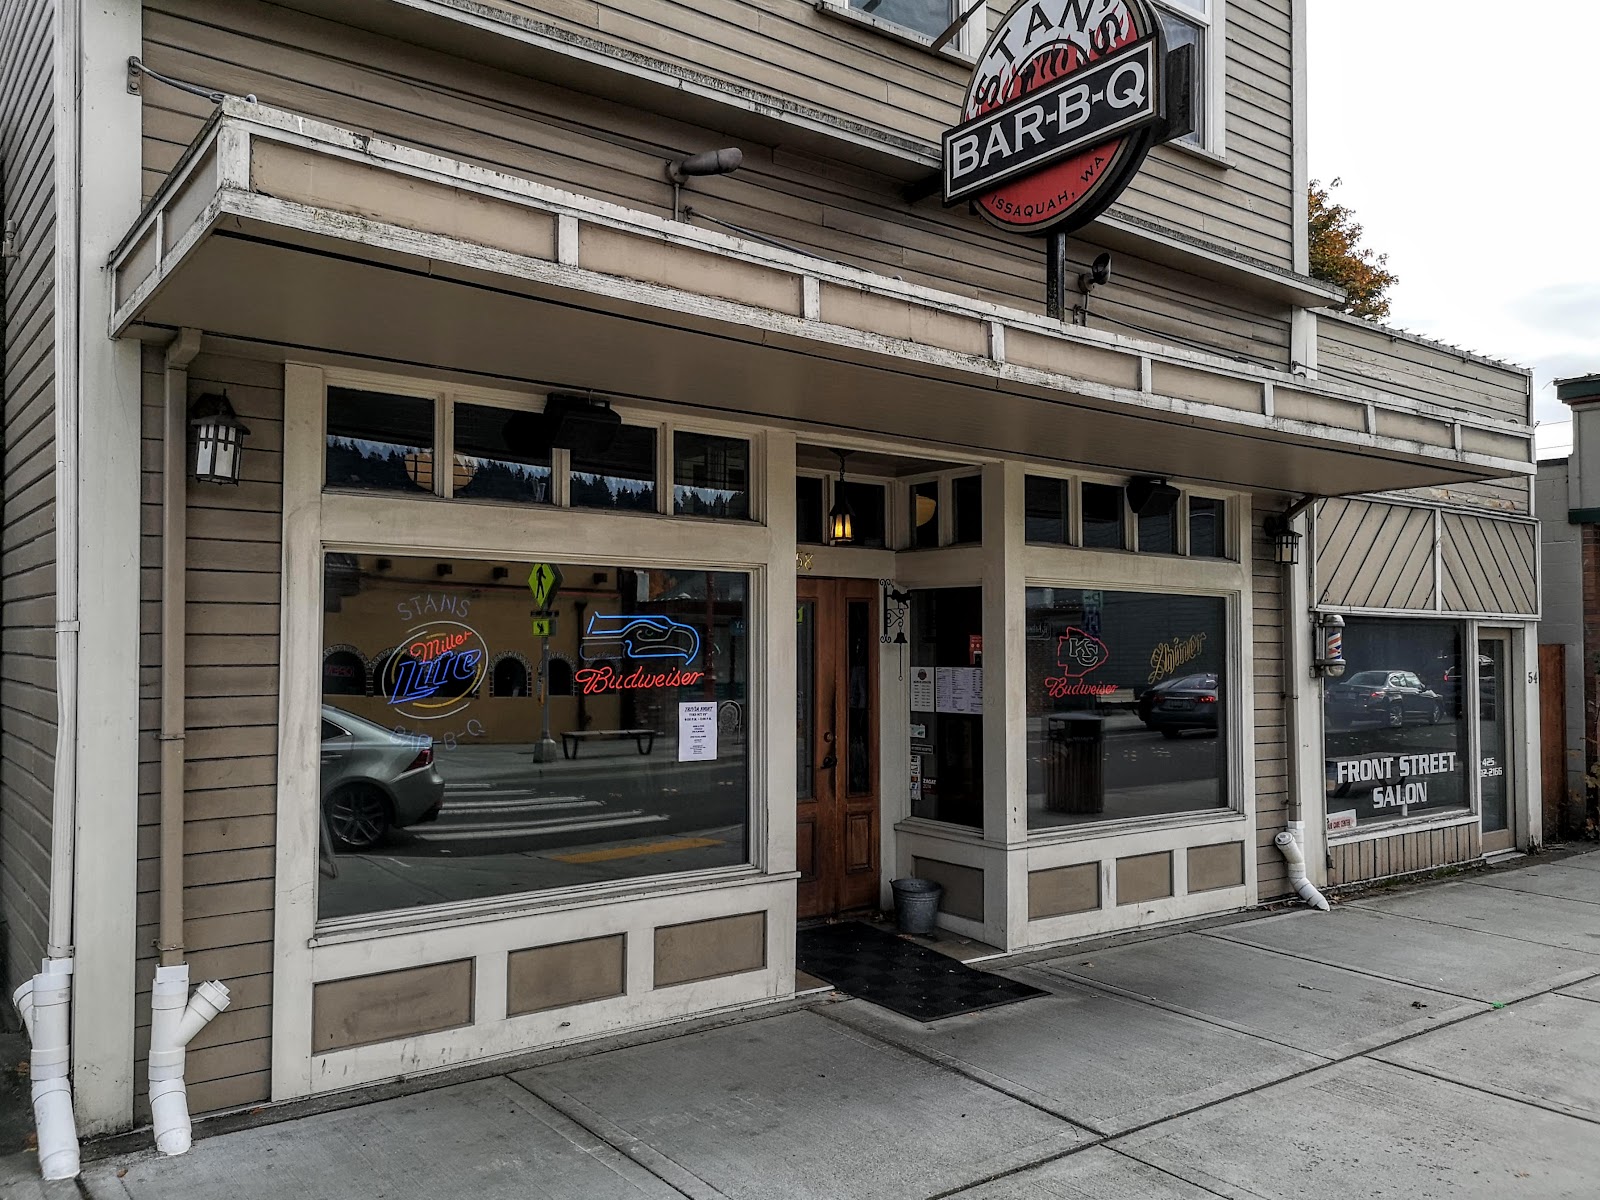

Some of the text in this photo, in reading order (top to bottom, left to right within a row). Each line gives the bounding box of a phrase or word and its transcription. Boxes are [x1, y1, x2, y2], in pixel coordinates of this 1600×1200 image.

[951, 60, 1147, 180] BAR-B-Q
[990, 156, 1105, 218] ISSAQUAH, WA
[397, 593, 471, 621] STANS
[410, 631, 473, 663] Miller
[575, 665, 704, 695] Budweiser
[1044, 677, 1119, 698] Budweiser
[1527, 671, 1538, 685] 54
[1337, 752, 1456, 783] FRONT STREET
[1373, 781, 1427, 808] SALON
